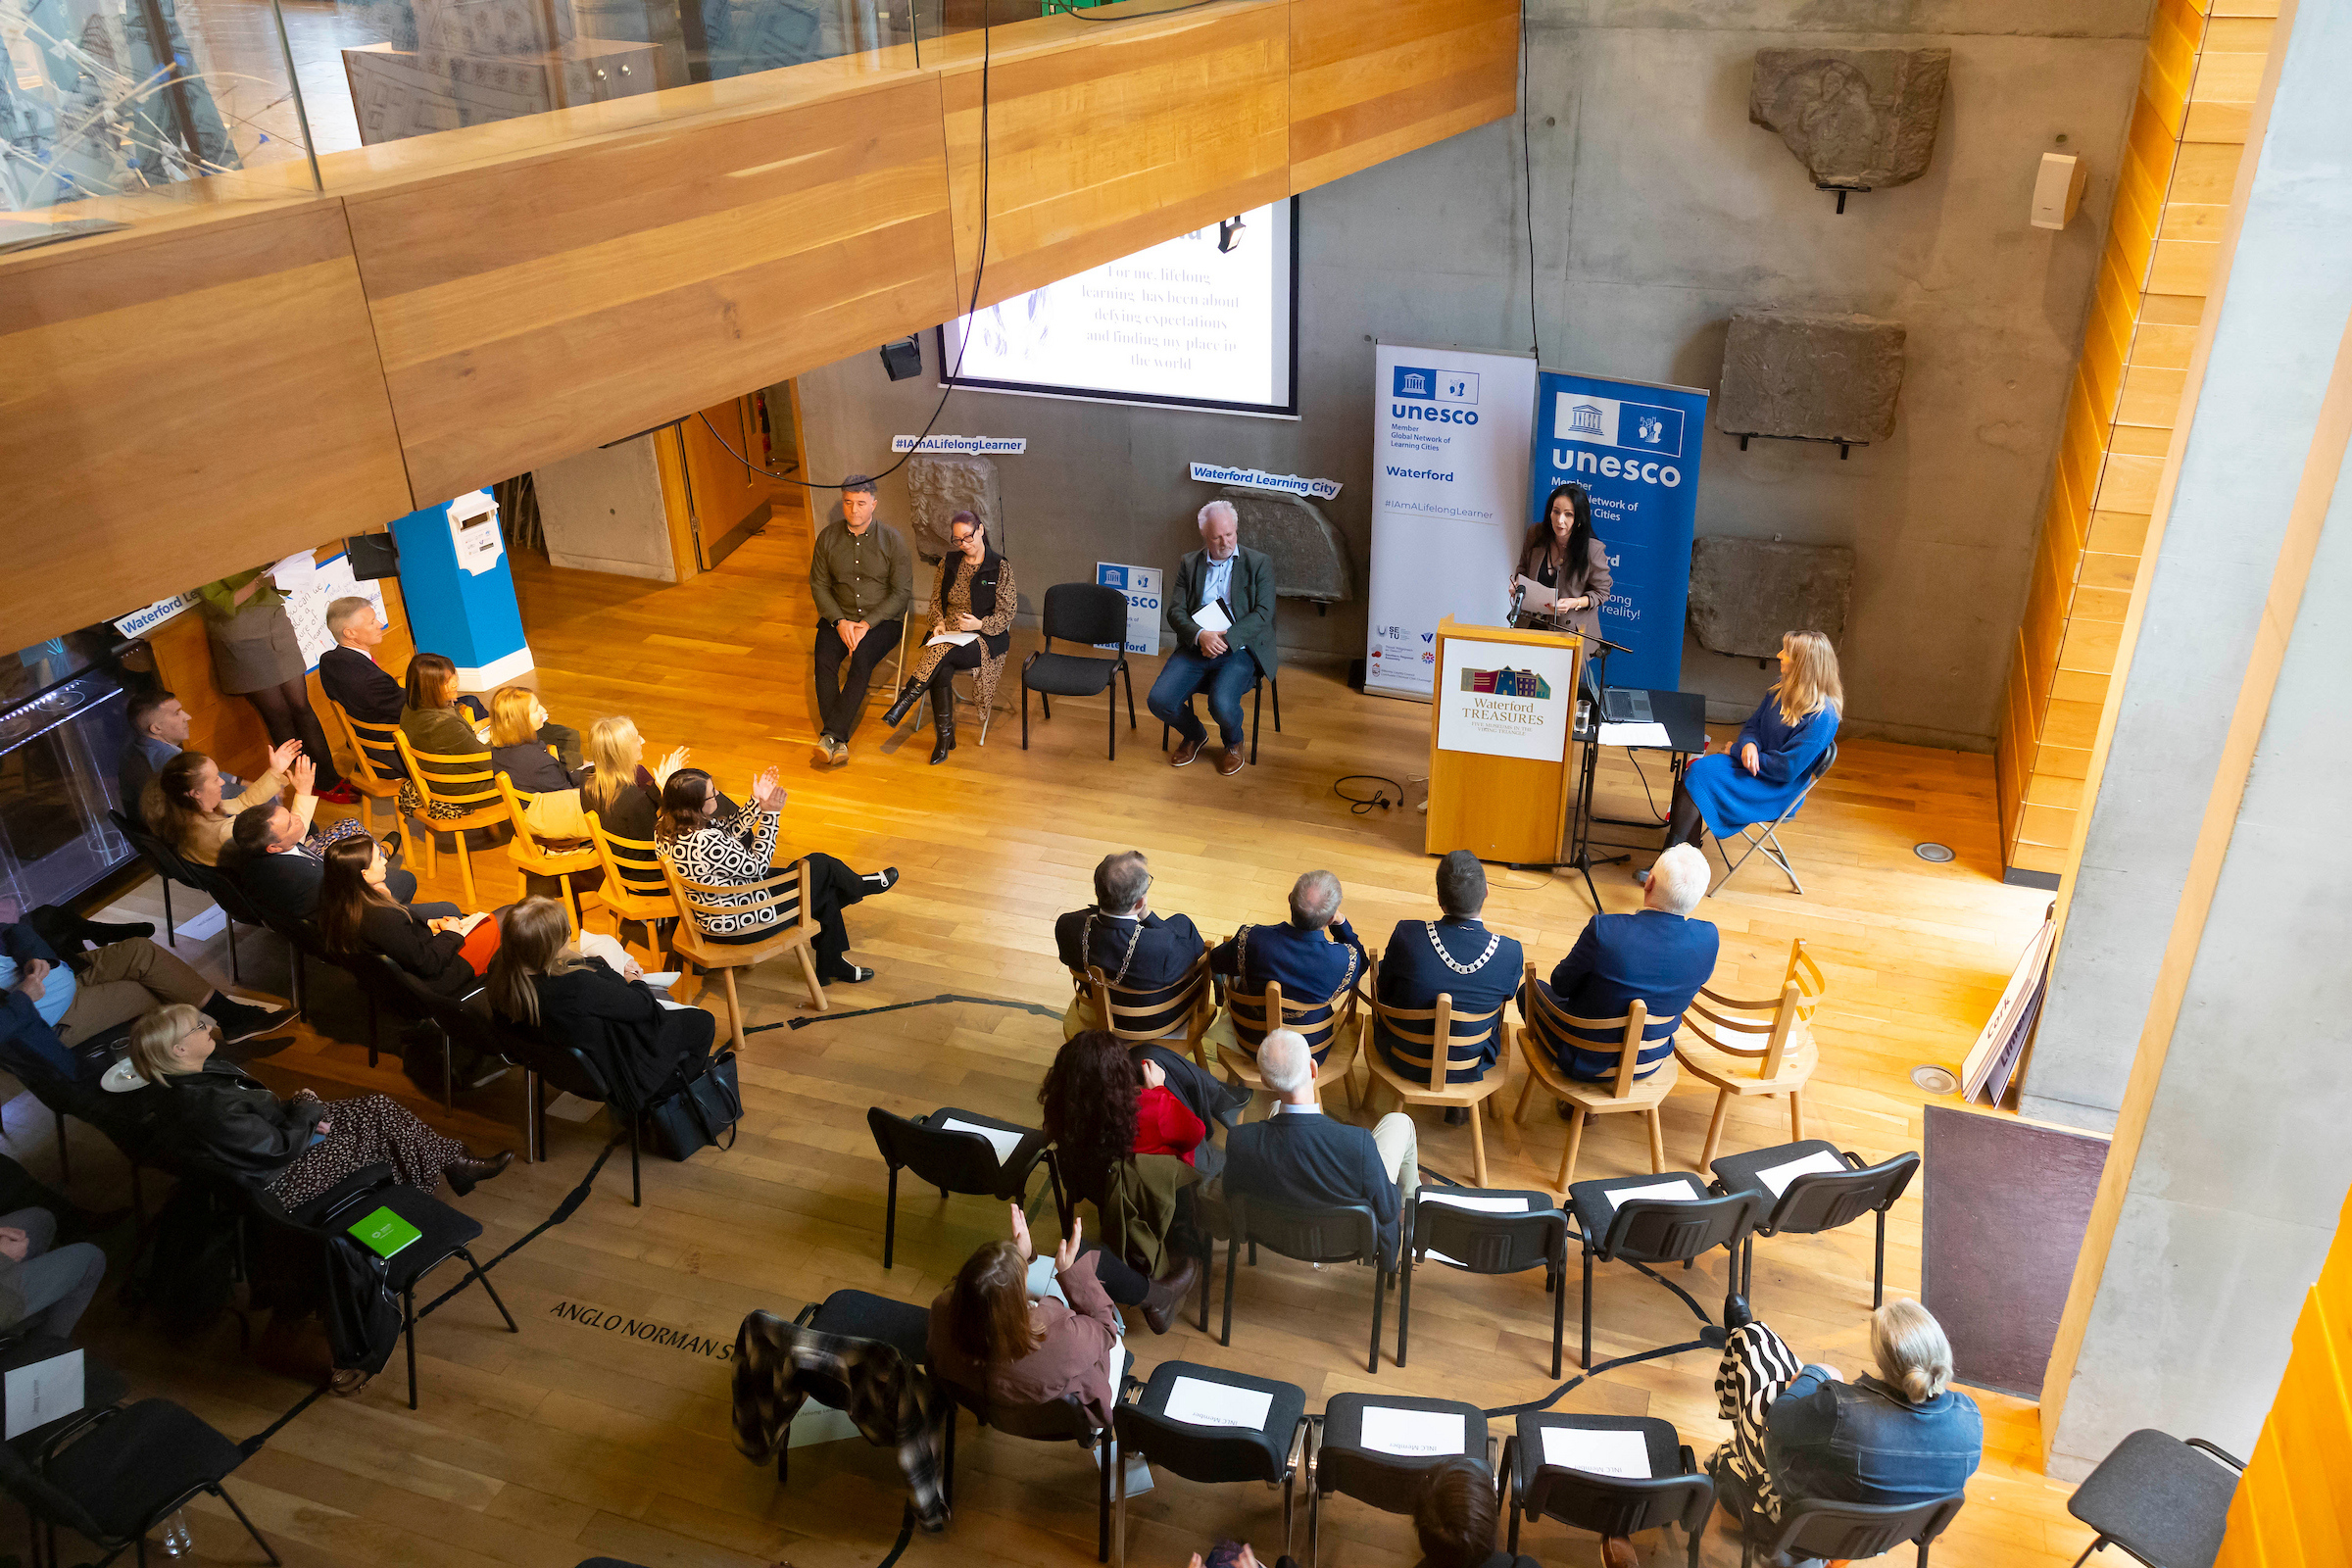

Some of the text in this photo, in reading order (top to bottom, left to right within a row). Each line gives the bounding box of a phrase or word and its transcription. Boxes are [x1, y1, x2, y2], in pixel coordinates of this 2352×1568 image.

[1161, 268, 1211, 285] lifelong
[1082, 284, 1239, 308] learning has been about
[1095, 308, 1227, 329] defying expectations
[1087, 330, 1237, 352] and finding my place in
[1131, 353, 1192, 370] the world
[1392, 404, 1479, 425] unesco
[896, 439, 1022, 451] #IAmALifelongLearner
[1391, 441, 1419, 451] Learning
[1386, 466, 1454, 482] Waterford
[1552, 449, 1681, 488] unesco
[1195, 466, 1337, 496] Waterford Learning City
[1385, 500, 1494, 519] #IAmALifelongLearner
[1593, 508, 1621, 521] Cities
[1627, 502, 1639, 512] of
[1124, 596, 1158, 610] esco
[122, 596, 182, 633] Waterford
[1601, 605, 1641, 621] reality!
[1098, 641, 1147, 652] ateford
[1474, 698, 1534, 713] Waterford
[1462, 708, 1544, 725] TREASURES
[1987, 996, 2011, 1039] Cork
[550, 1301, 622, 1331] ANGLO
[621, 1319, 719, 1356] NORMAN
[1192, 1411, 1221, 1423] Member
